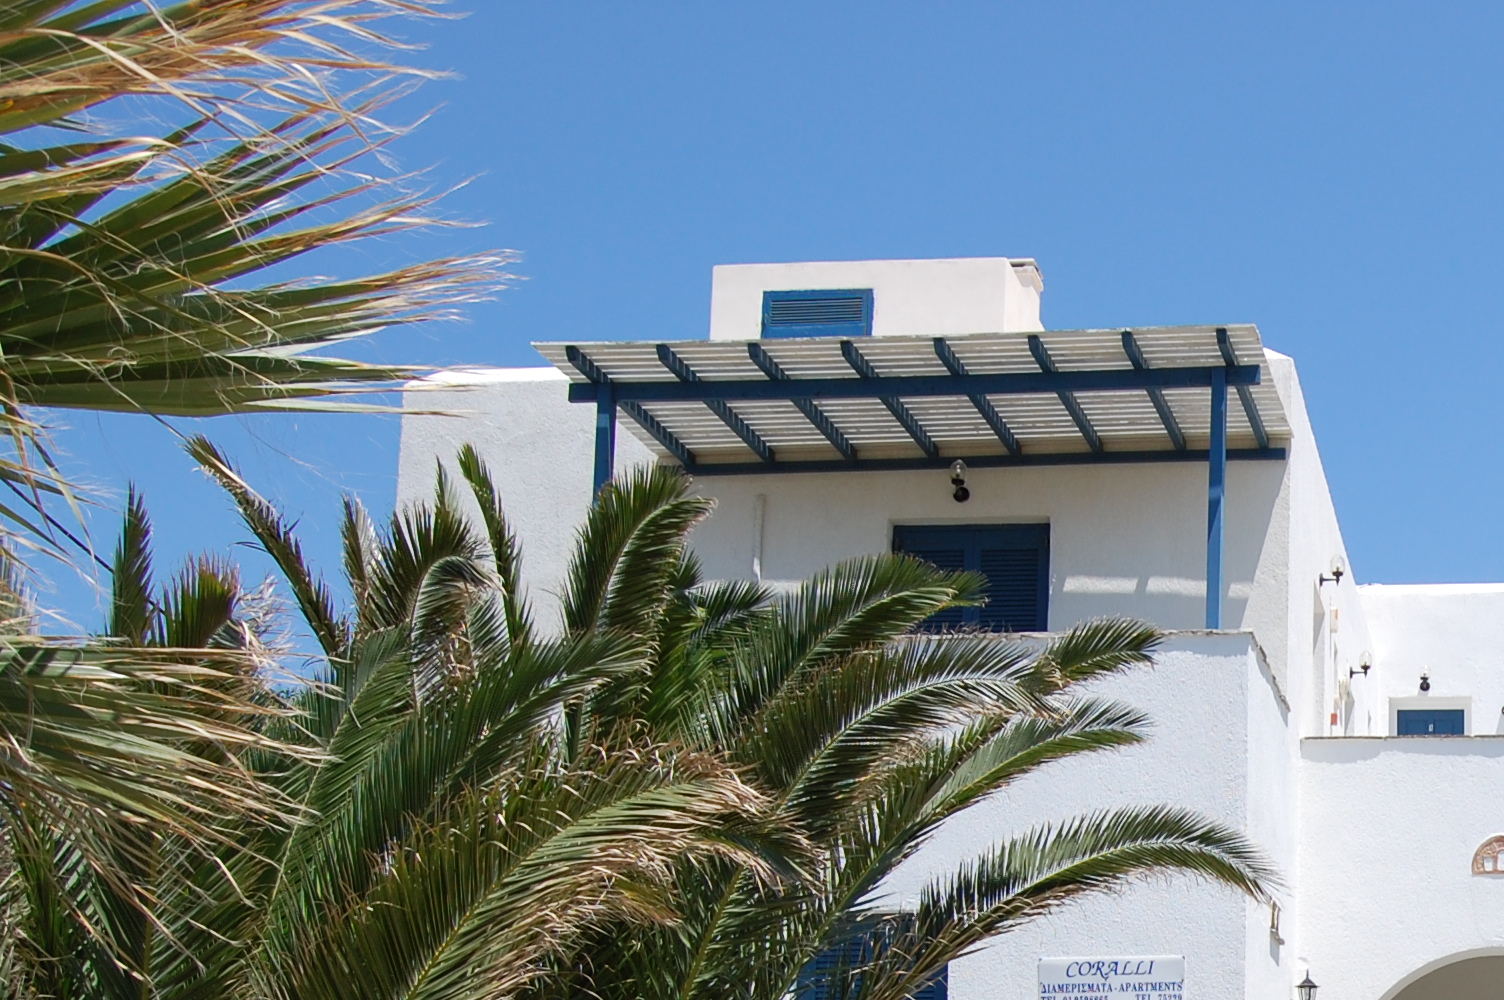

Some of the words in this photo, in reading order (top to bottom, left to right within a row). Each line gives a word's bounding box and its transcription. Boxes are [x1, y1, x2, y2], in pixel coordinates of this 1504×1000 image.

[1066, 960, 1155, 981] CORALLI
[1041, 983, 1113, 994] ΔΙΑΜΕΡΙΣΜΑΤΑ
[1119, 982, 1183, 993] APARTMENTS
